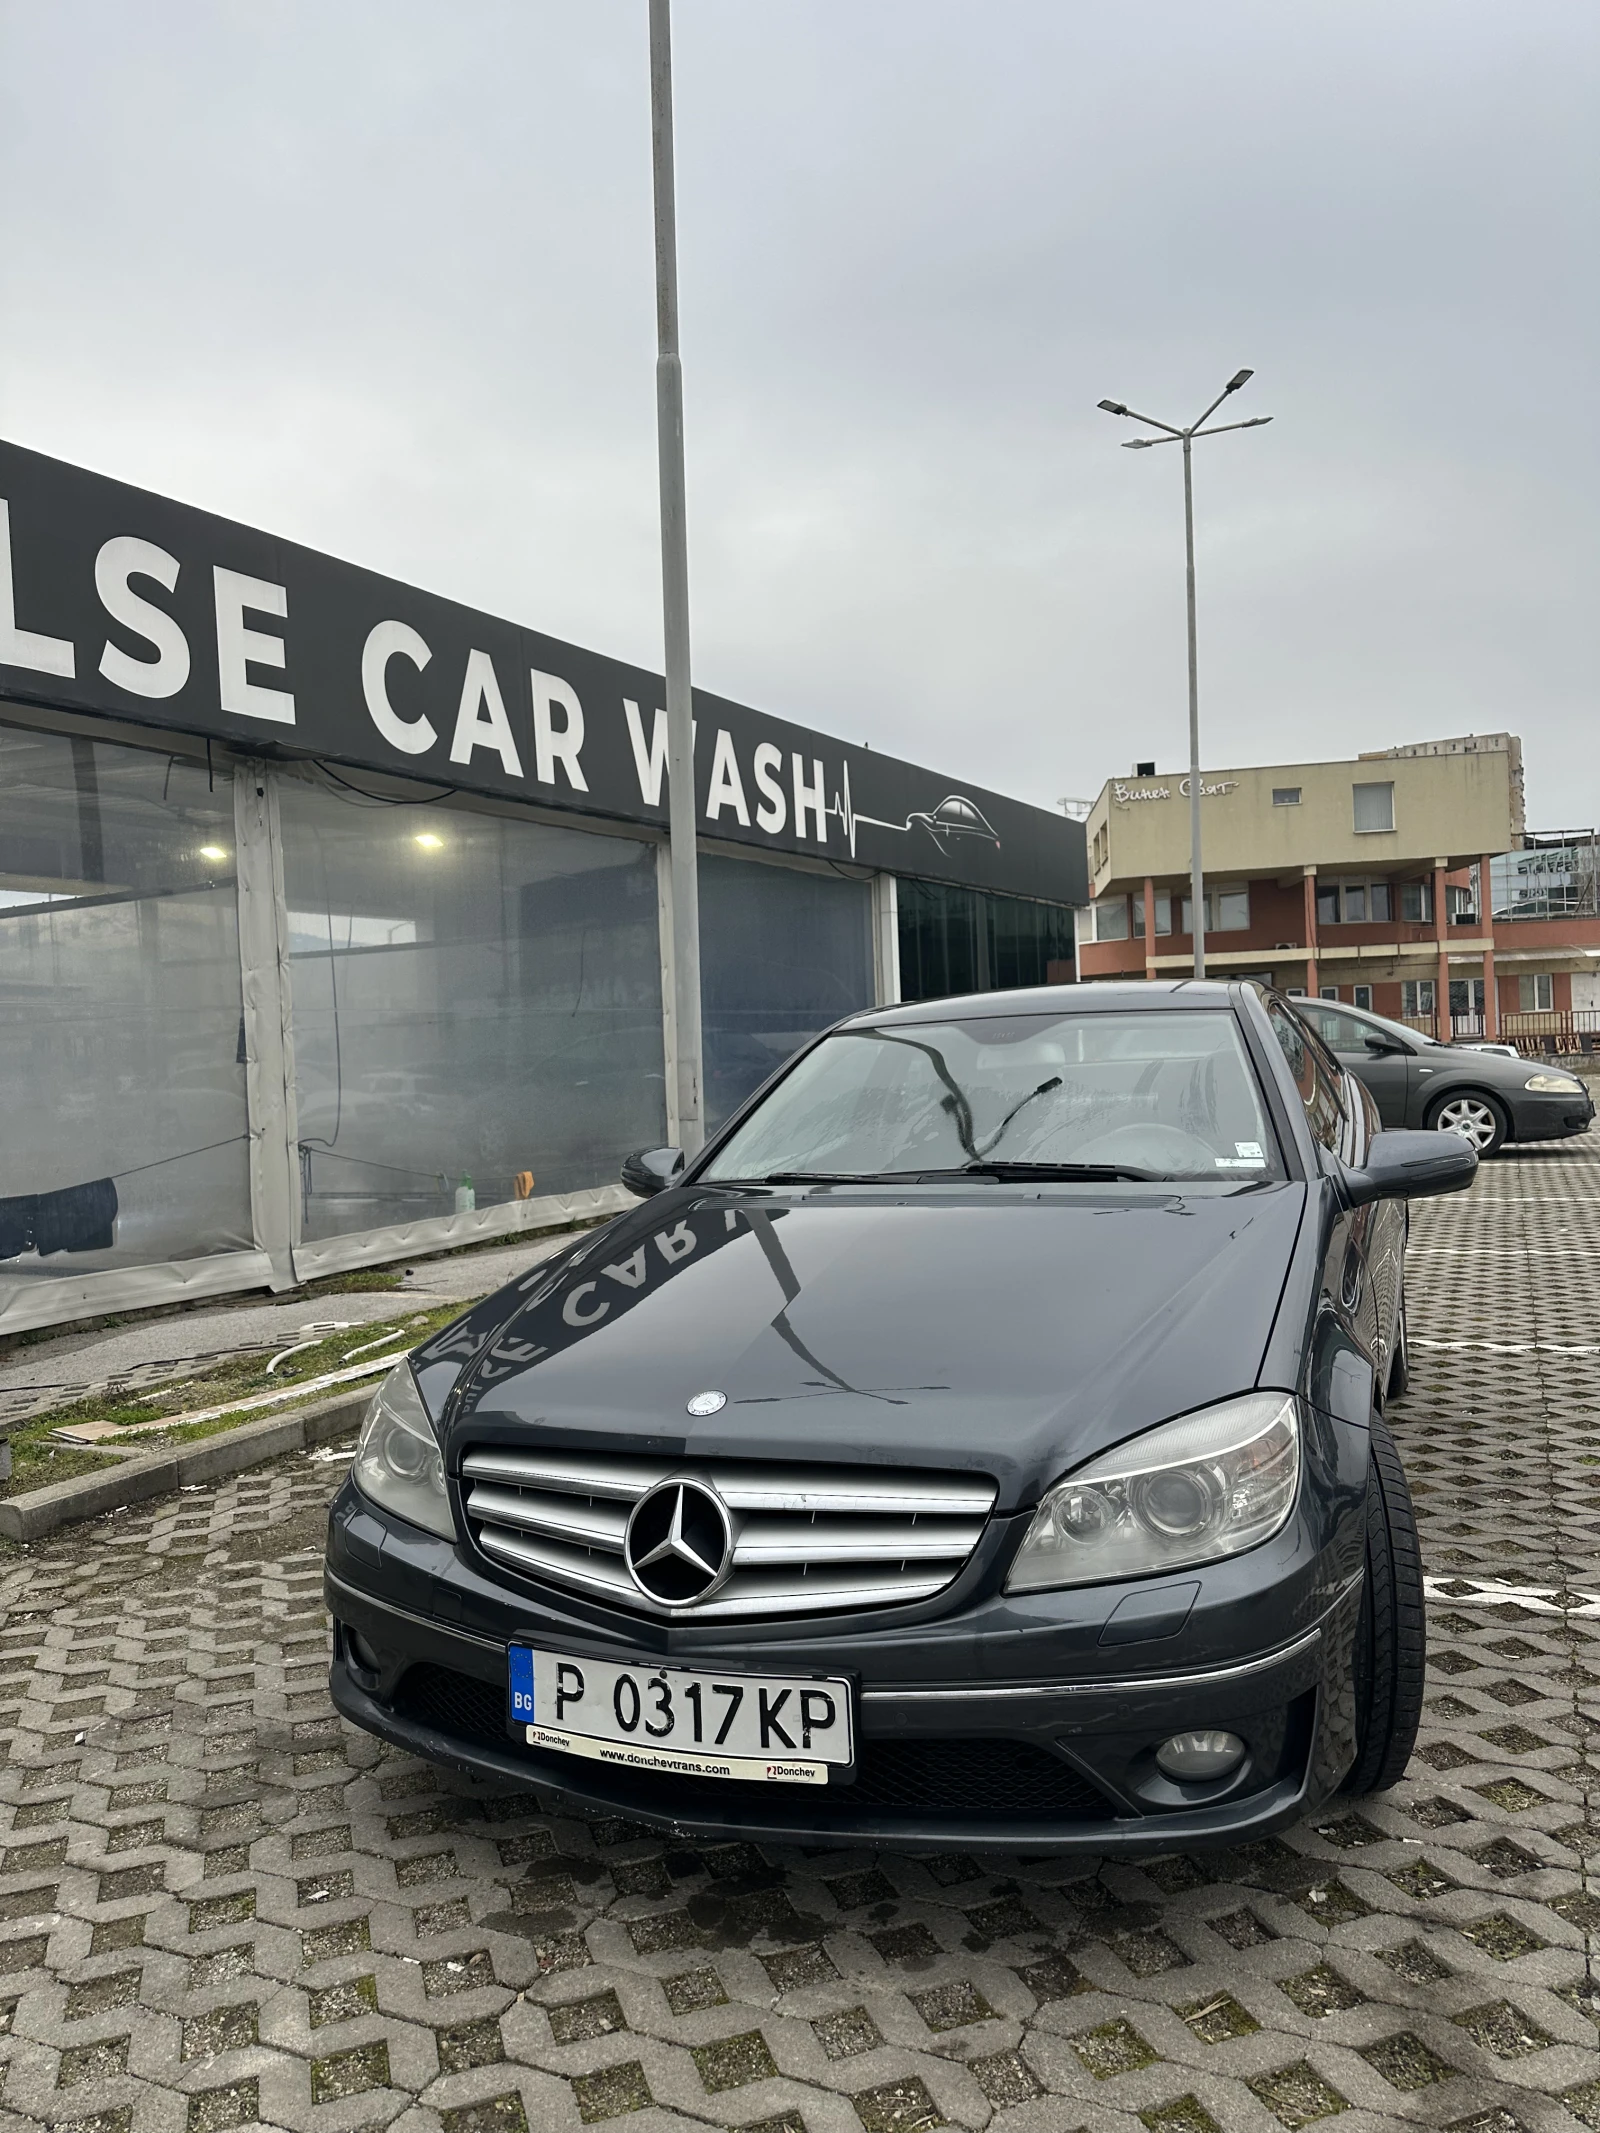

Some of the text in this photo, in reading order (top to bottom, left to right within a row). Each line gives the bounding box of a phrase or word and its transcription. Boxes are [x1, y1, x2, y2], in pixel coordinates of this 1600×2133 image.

[361, 620, 589, 792] CAR
[623, 698, 827, 843] WASH
[514, 1691, 533, 1712] BG
[556, 1662, 585, 1720] P
[599, 1749, 731, 1775] www.donchevtrans.com
[777, 1765, 816, 1777] Donchev
